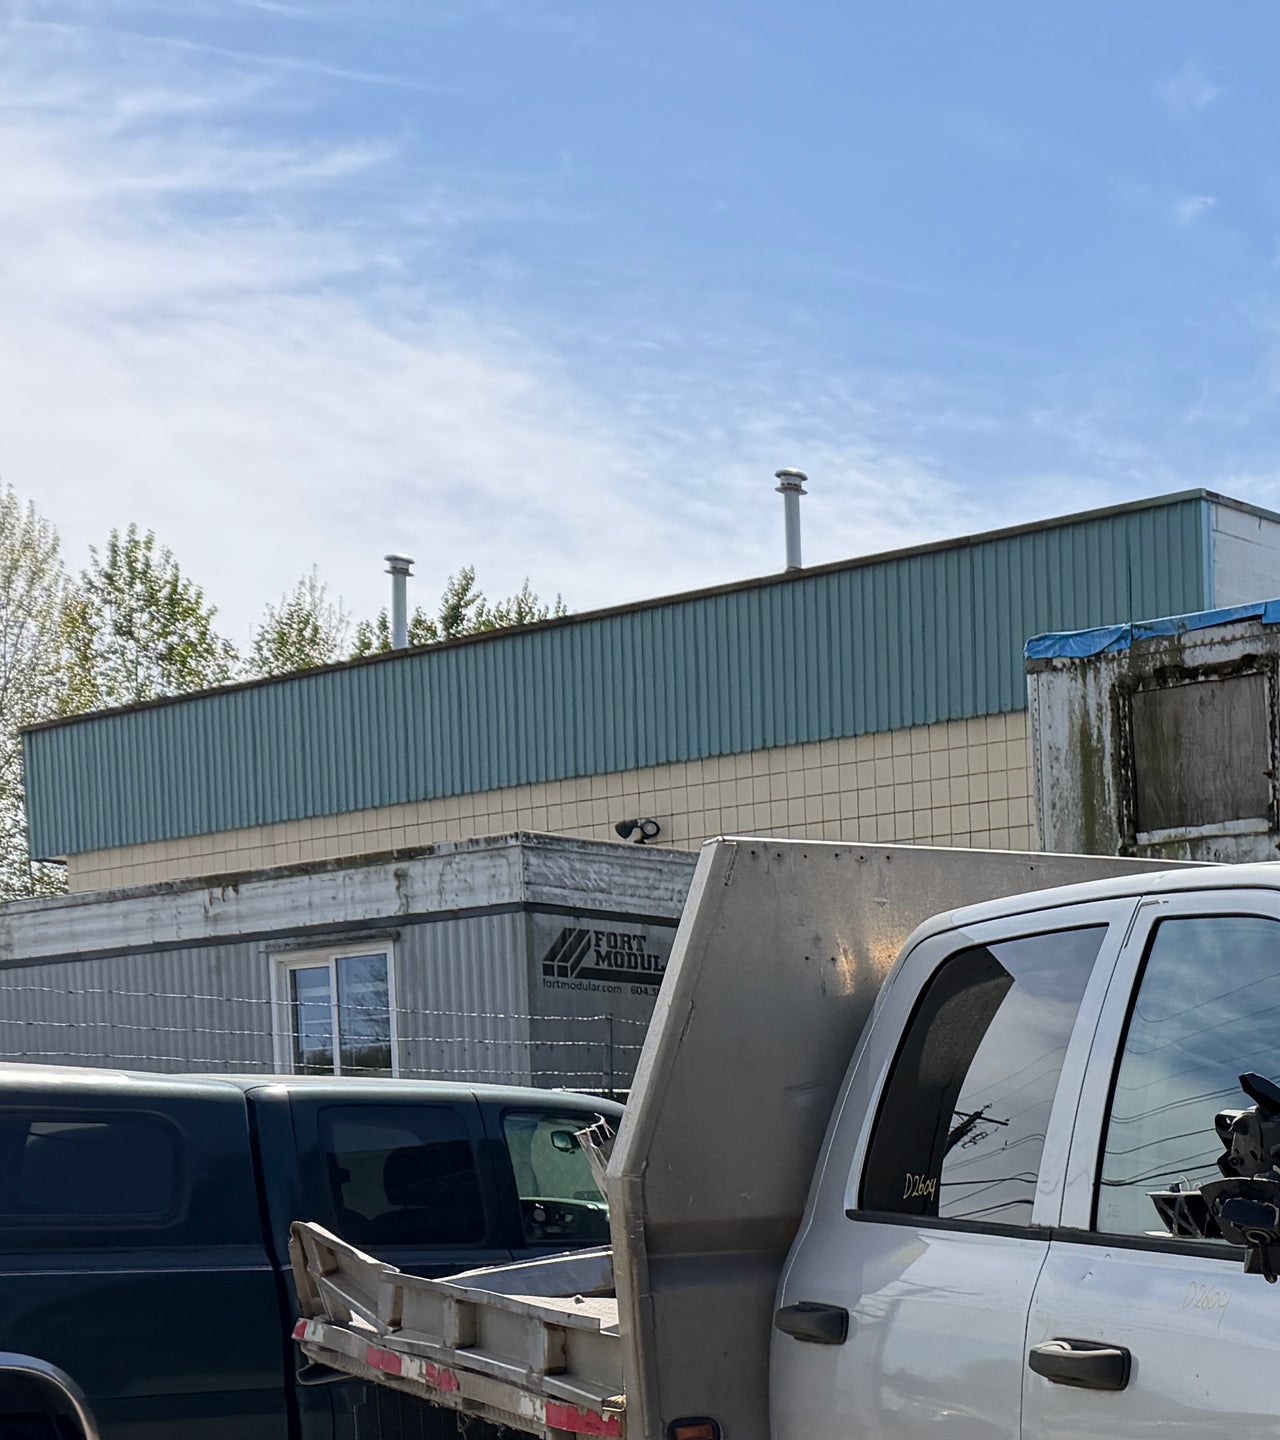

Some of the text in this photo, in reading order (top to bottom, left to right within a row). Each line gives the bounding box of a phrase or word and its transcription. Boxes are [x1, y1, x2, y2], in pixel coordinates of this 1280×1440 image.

[593, 931, 647, 953] FORT
[593, 950, 666, 973] MODUL
[542, 978, 622, 994] fortmodular.com
[903, 1173, 937, 1201] D2604
